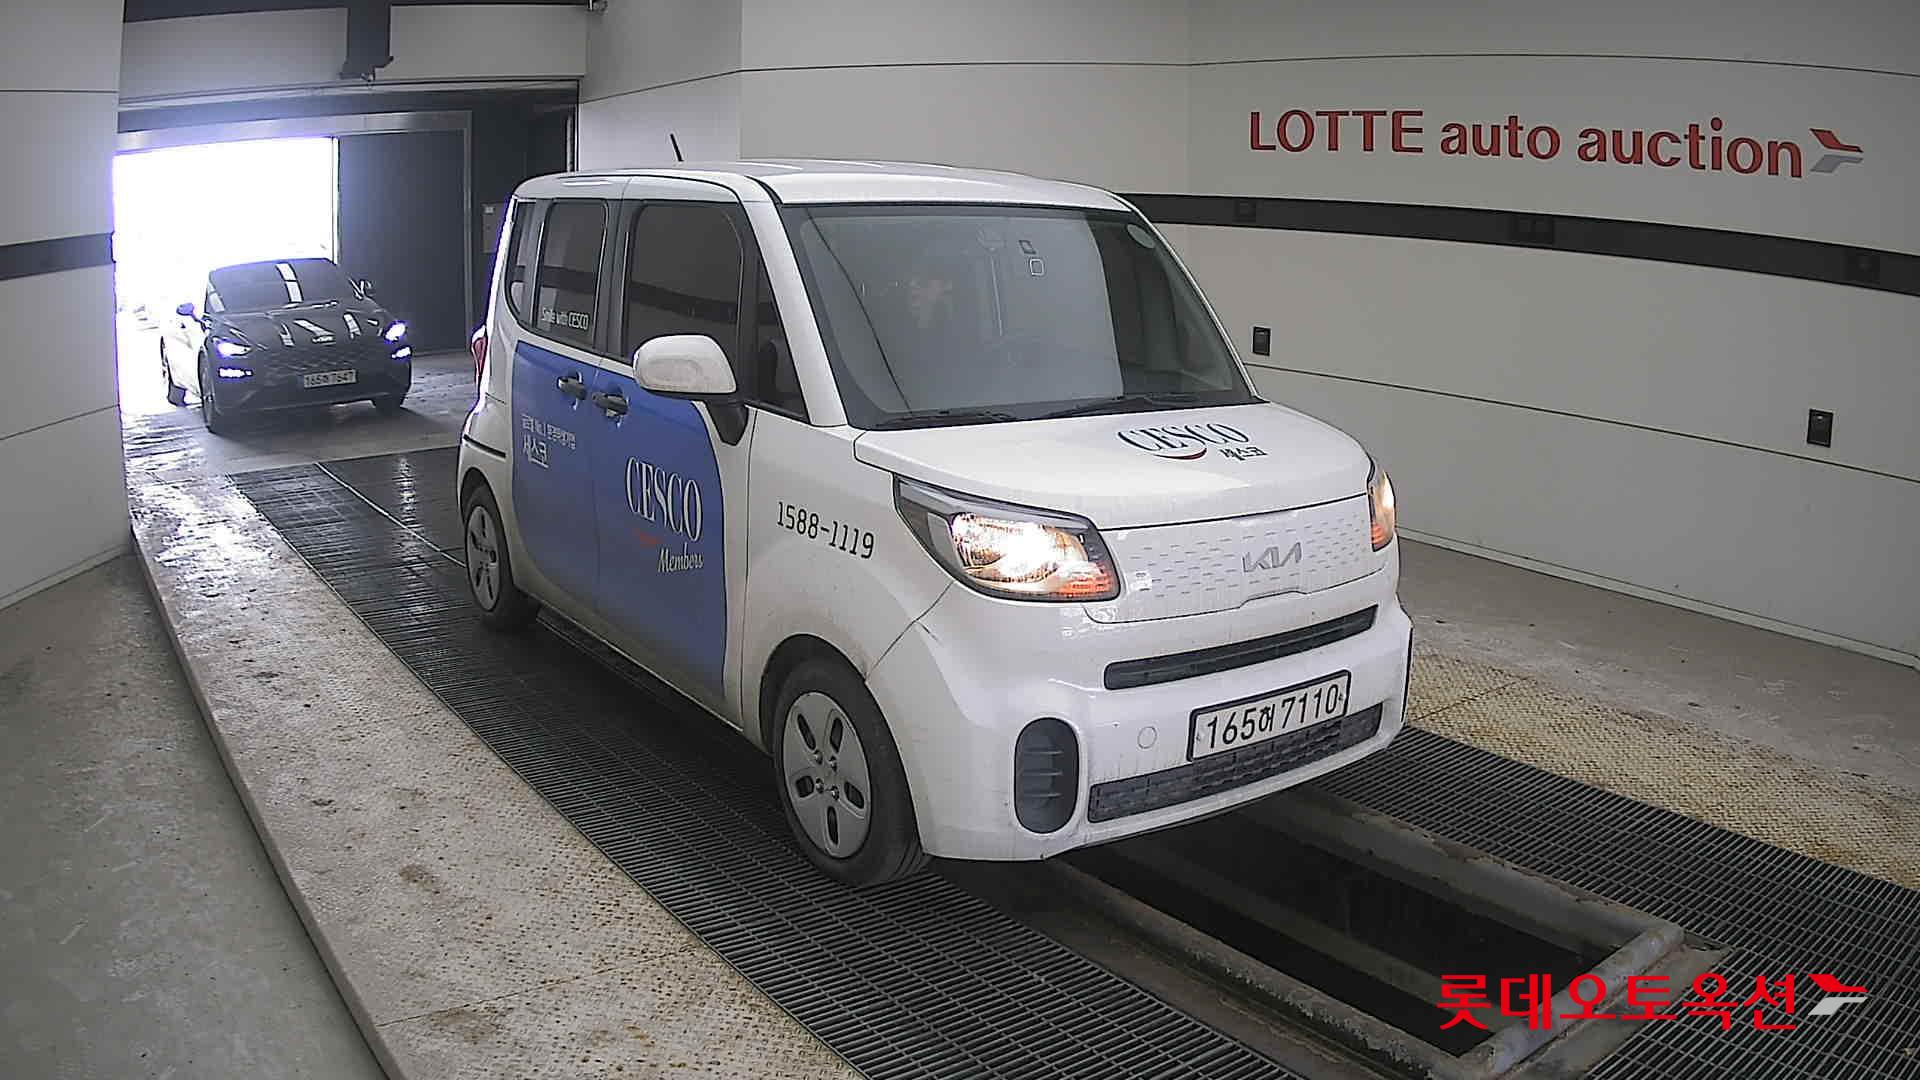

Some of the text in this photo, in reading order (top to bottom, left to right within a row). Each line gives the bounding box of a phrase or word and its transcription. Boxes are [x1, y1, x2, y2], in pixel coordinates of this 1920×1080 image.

[1250, 110, 1803, 178] LOTTE auto auction
[568, 311, 589, 330] CESCO
[1117, 423, 1250, 452] CESCO
[626, 456, 702, 542] CESCO
[776, 501, 875, 559] 1588-1119
[657, 541, 704, 573] Members
[1242, 541, 1302, 572] KIA
